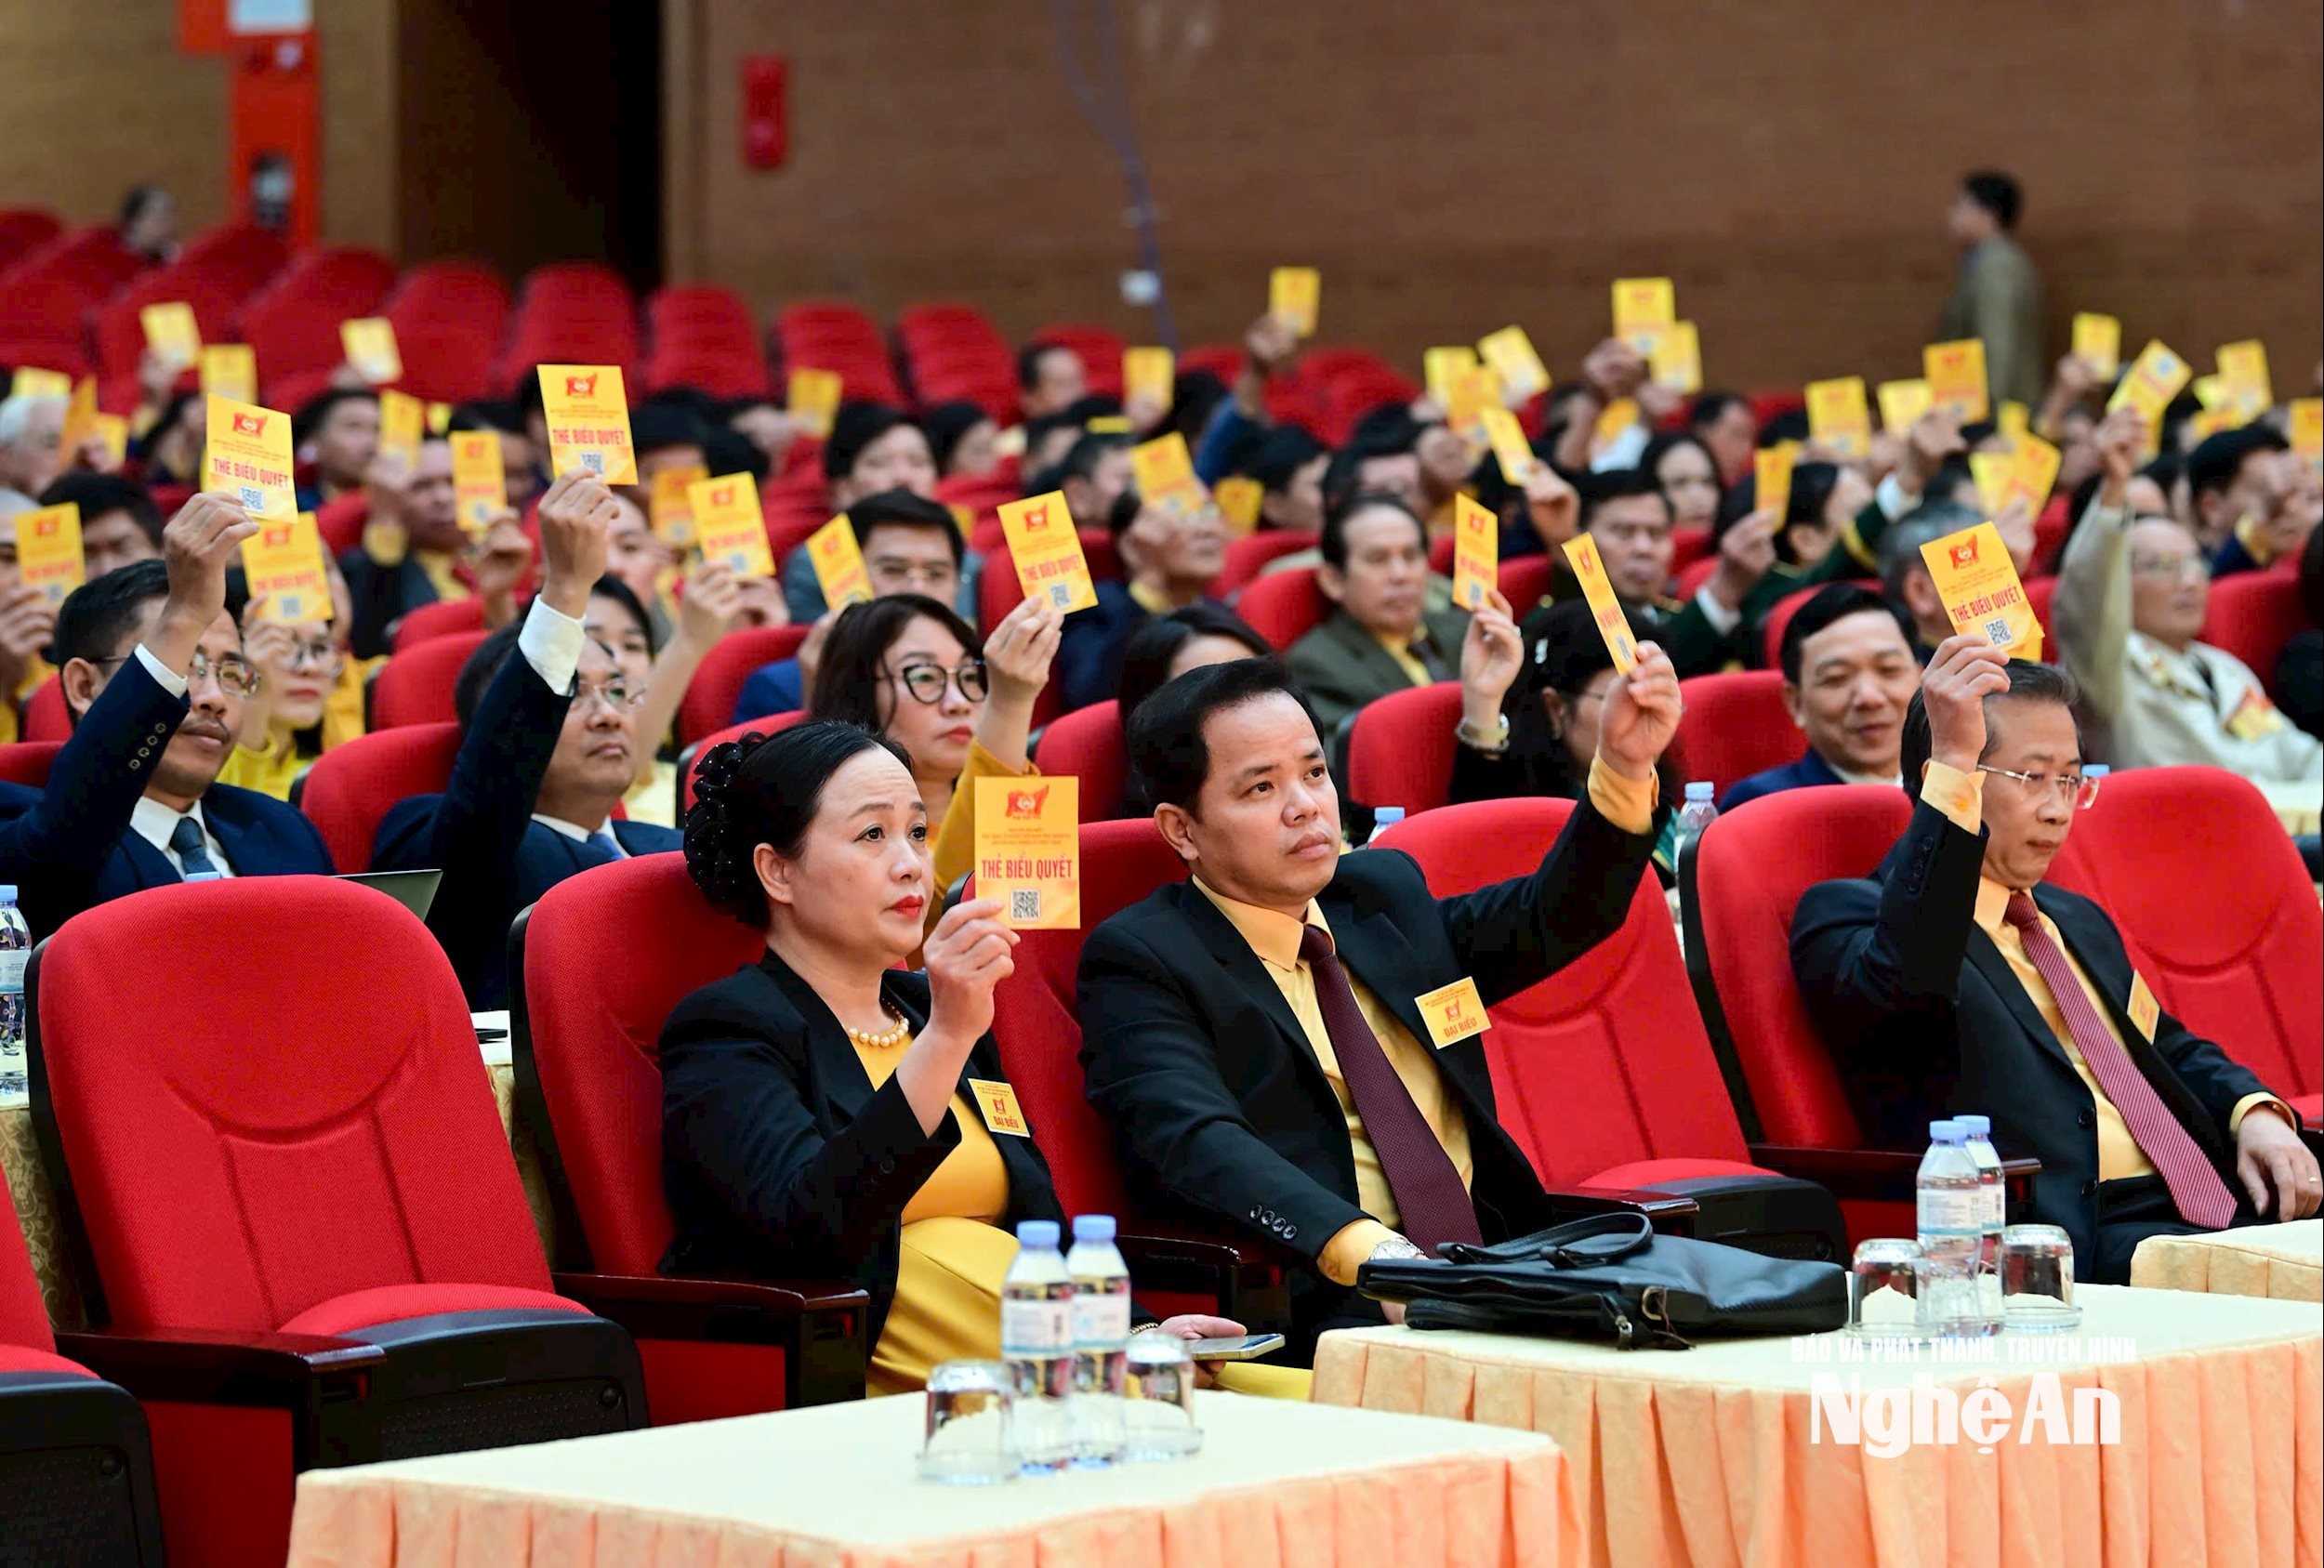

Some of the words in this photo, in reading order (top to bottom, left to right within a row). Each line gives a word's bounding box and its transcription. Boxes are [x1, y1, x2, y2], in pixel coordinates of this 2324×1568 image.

[982, 852, 1002, 878] THẺ
[1006, 851, 1032, 878] BIỂU
[1037, 852, 1072, 881] QUYẾT
